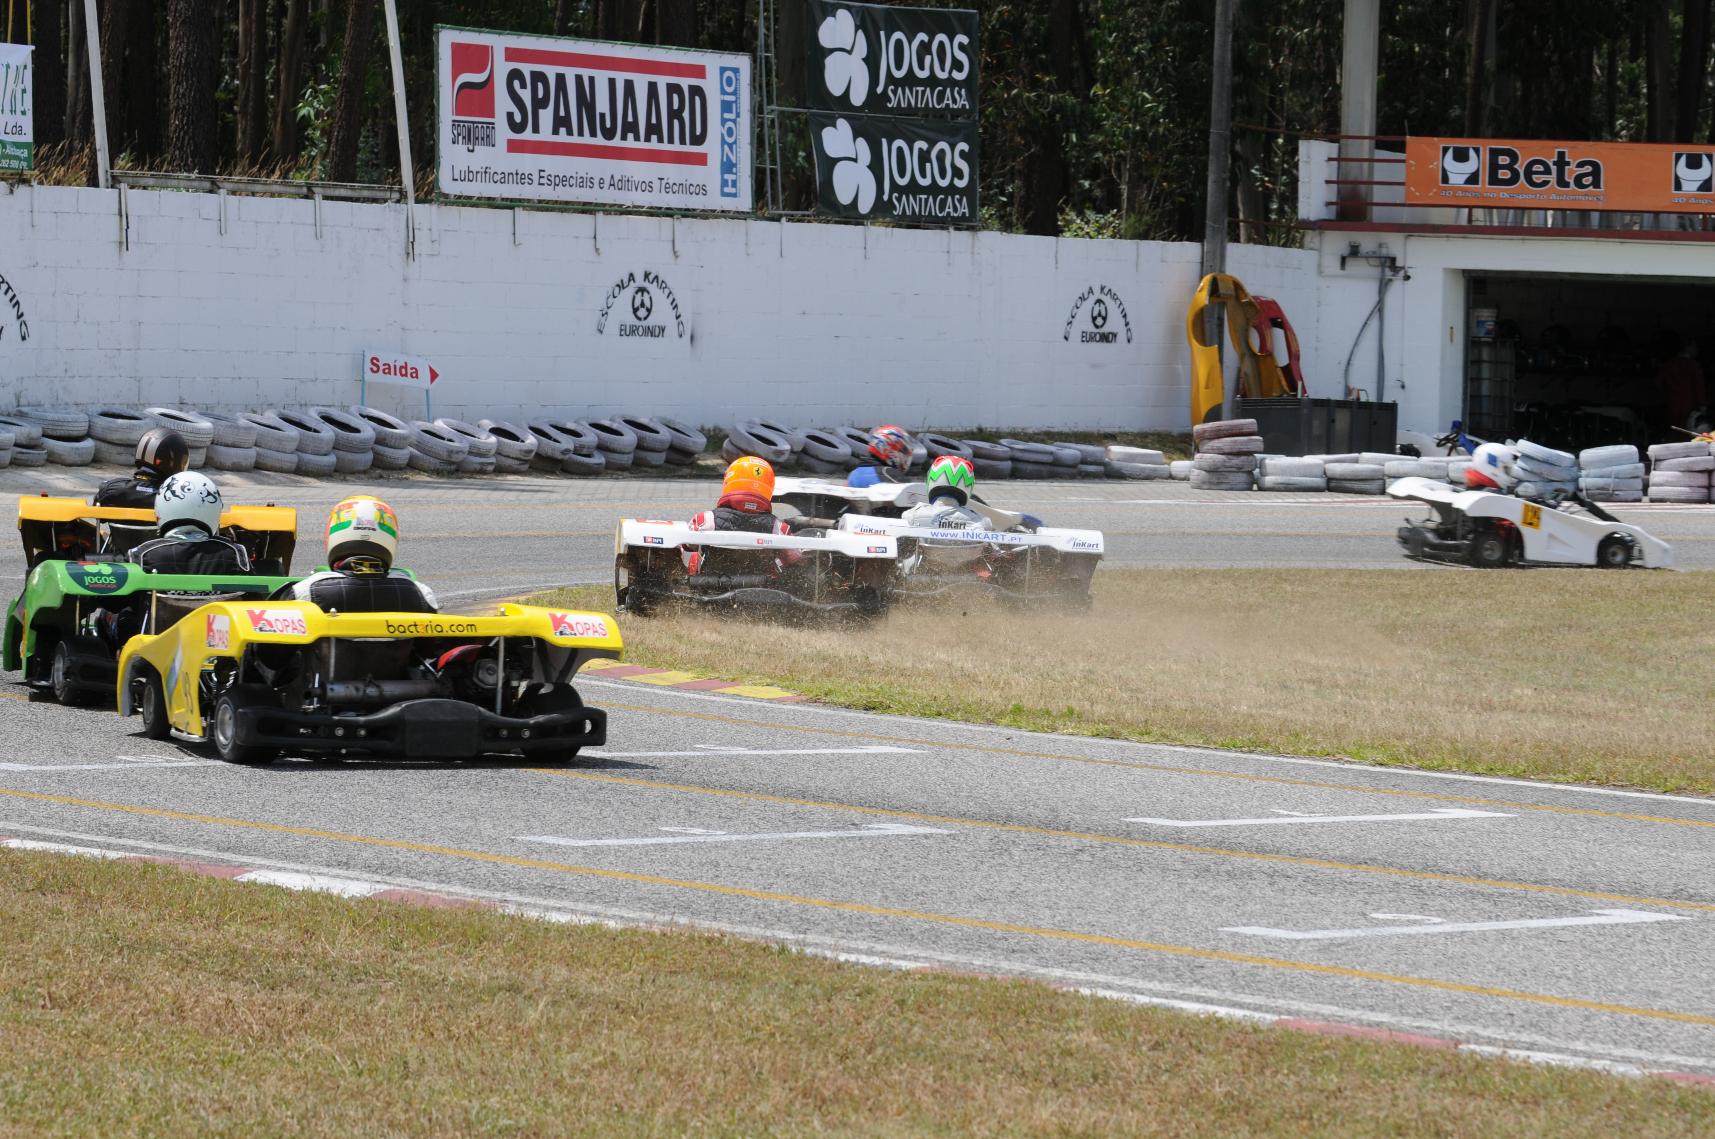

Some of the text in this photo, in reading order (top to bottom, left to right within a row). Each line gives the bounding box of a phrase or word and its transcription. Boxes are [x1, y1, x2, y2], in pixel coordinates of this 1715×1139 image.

[876, 30, 970, 94] JOGOS
[506, 68, 708, 146] SPANJAARD
[451, 122, 496, 153] SPANJAARD
[451, 165, 708, 196] Lubrificantes Especiais e Aditivos Técnicos
[881, 138, 970, 201] JOGOS
[1487, 146, 1603, 190] Beta
[597, 269, 686, 339] ESCOLA KARTING
[1063, 284, 1133, 344] ESCOLA KARTING
[619, 323, 667, 338] EUROINDY
[1080, 330, 1119, 343] EUROINDY
[369, 356, 420, 379] Saída
[84, 575, 117, 586] JOGOS
[246, 609, 308, 635] KOPAS
[548, 612, 608, 637] KOPAS
